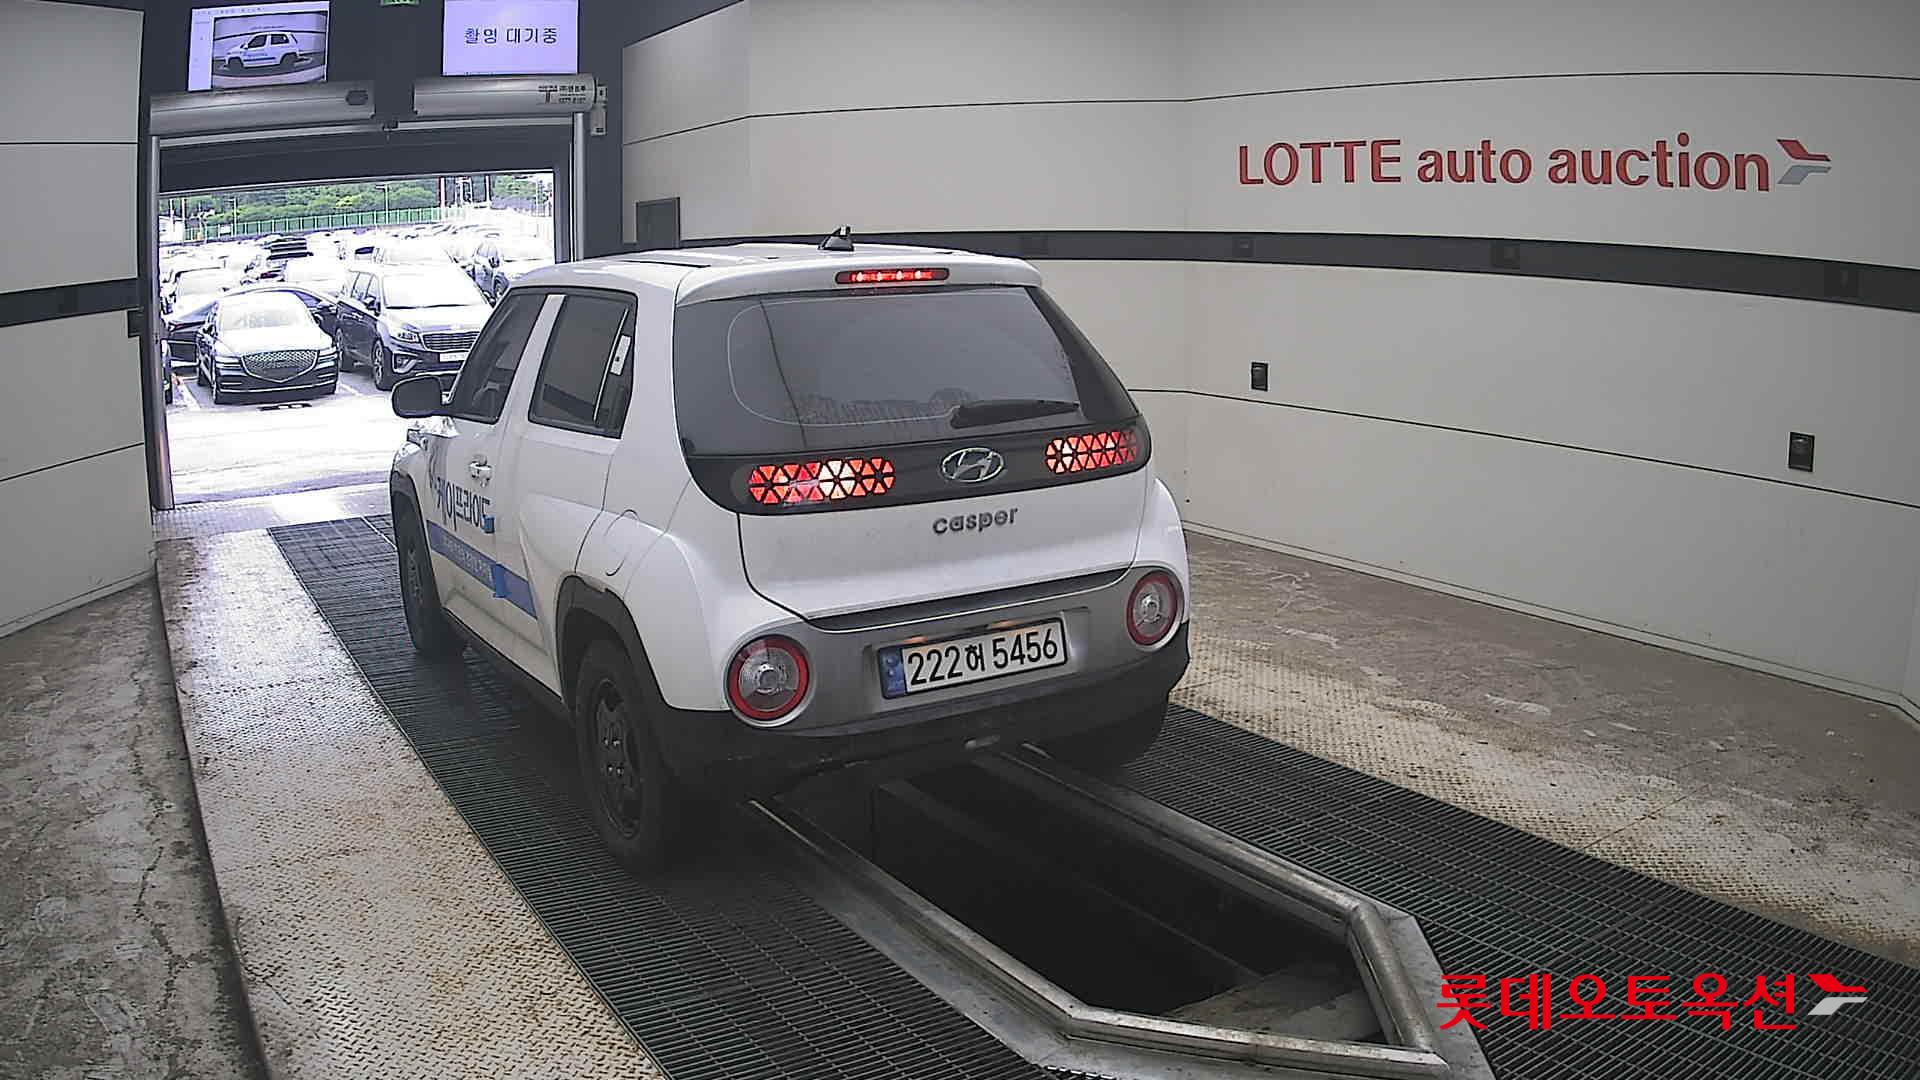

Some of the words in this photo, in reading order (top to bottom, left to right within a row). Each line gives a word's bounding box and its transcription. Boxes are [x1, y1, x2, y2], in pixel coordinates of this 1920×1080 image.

[465, 28, 498, 45] 촬영
[506, 28, 558, 45] 대기중
[1239, 139, 1401, 186] LOTTE
[1417, 139, 1532, 184] auto
[1549, 132, 1770, 192] auction
[933, 508, 1018, 534] casper
[907, 643, 986, 686] 222허
[992, 628, 1058, 669] 5456
